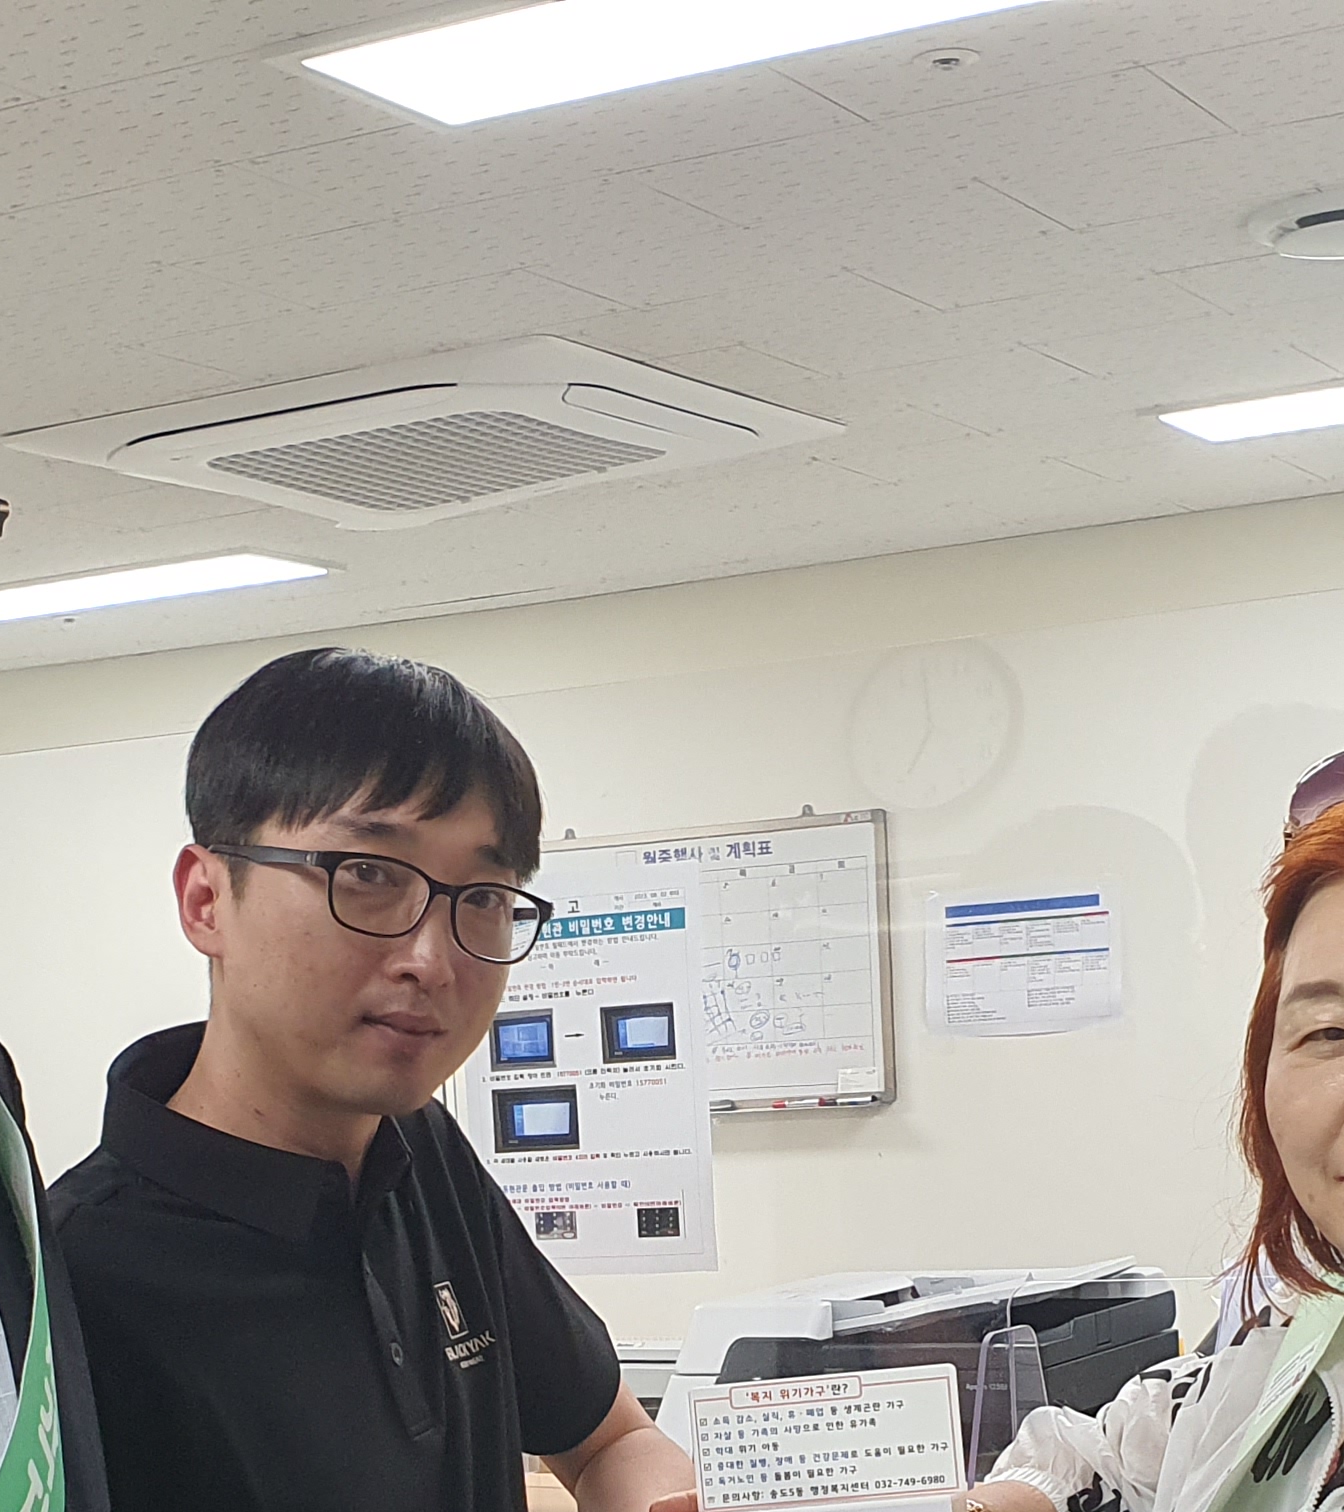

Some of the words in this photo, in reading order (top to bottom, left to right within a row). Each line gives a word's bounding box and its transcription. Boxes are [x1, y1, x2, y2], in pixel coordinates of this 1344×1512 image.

[726, 841, 773, 860] 계획표
[567, 900, 581, 915] 고
[541, 923, 563, 939] 현관
[568, 918, 615, 936] 비밀번호
[621, 911, 671, 931] 변경안내
[608, 1079, 633, 1089] 비밀번호
[714, 1431, 732, 1441] 자살
[784, 1423, 820, 1434] 사망으로
[850, 1418, 877, 1429] 유가족
[762, 1442, 780, 1452] 아동
[813, 1450, 859, 1464] 건강문제로
[864, 1446, 892, 1458] 도움이
[897, 1443, 925, 1456] 필요한
[930, 1442, 949, 1452] 가구
[718, 1474, 755, 1486] 독거노인
[807, 1468, 834, 1480] 필요한
[840, 1465, 857, 1475] 가구
[722, 1490, 765, 1503] 문의사항:
[770, 1487, 804, 1500] 송도5동
[810, 1481, 869, 1496] 행정복지센터
[874, 1475, 946, 1489] 032-749-6980
